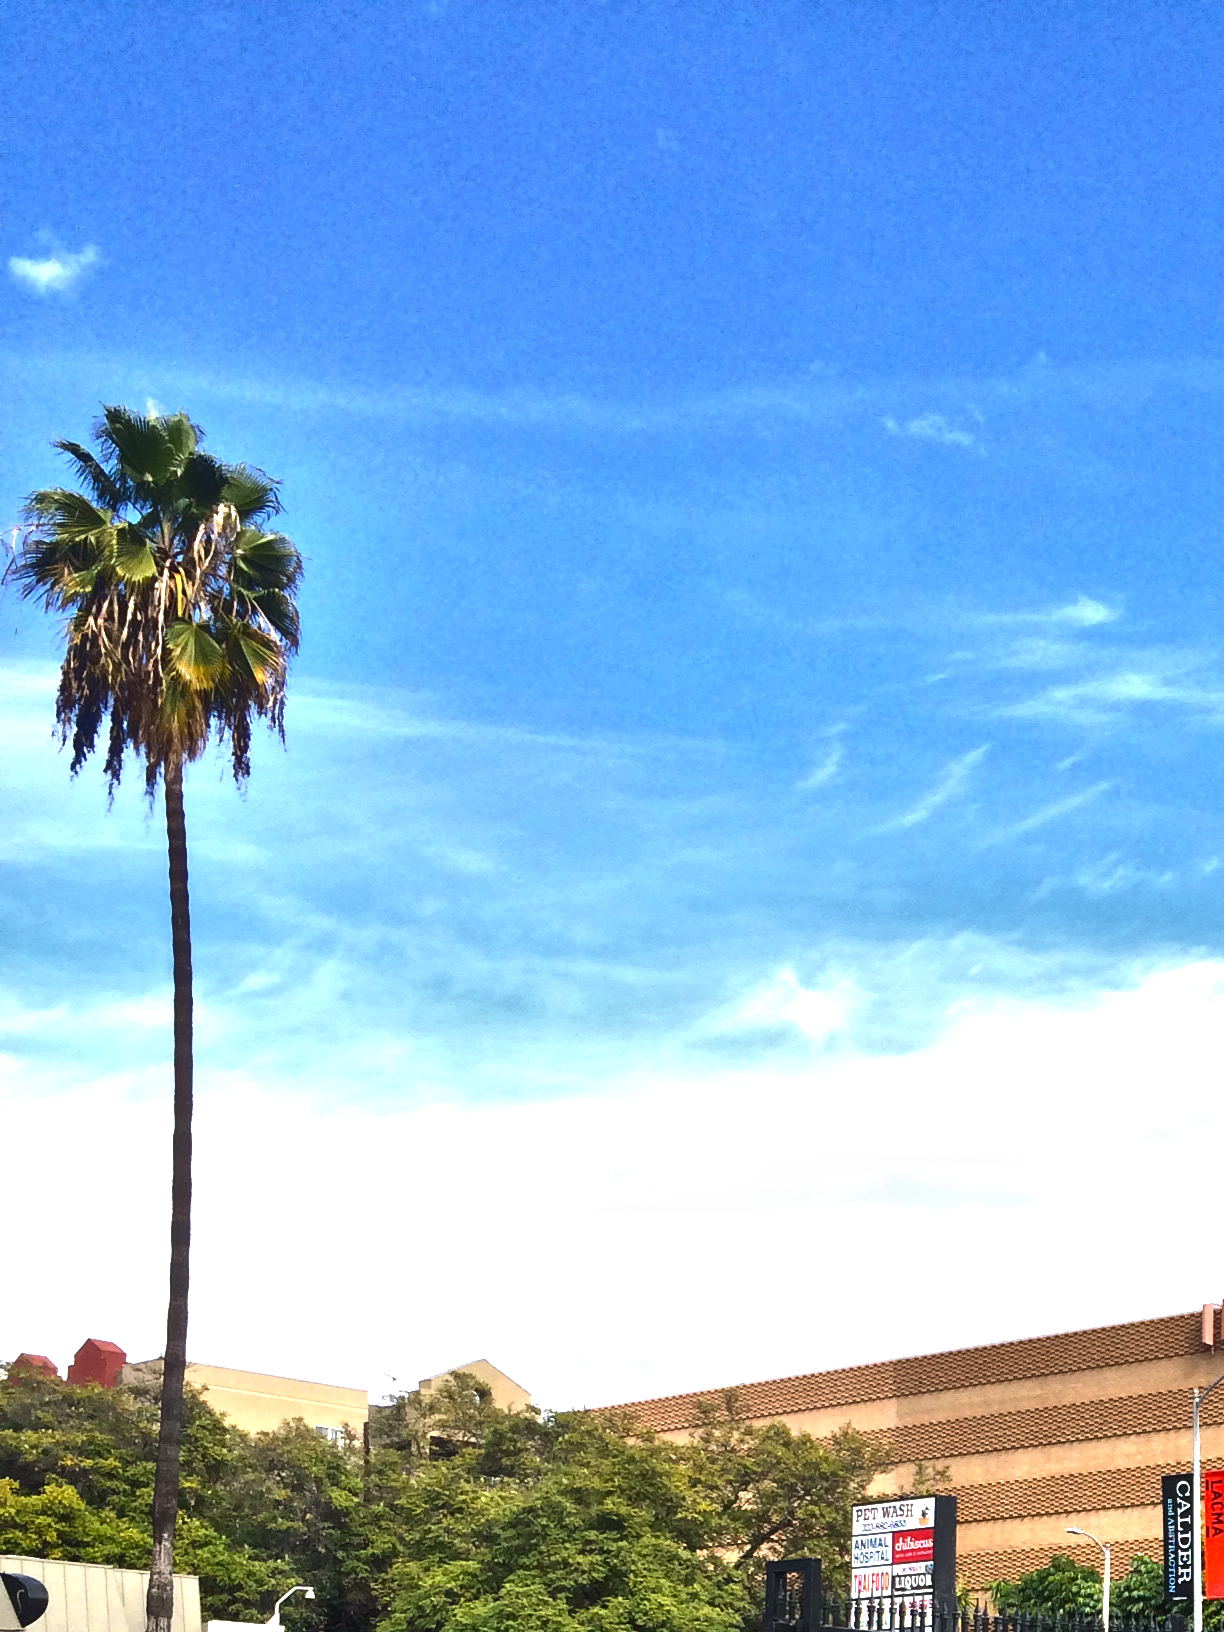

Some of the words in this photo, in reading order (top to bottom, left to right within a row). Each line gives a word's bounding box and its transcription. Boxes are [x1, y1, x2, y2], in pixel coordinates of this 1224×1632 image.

[856, 1507, 878, 1522] PET
[882, 1504, 914, 1518] WASH
[1167, 1499, 1175, 1516] and
[1210, 1480, 1224, 1538] LACMA
[1176, 1480, 1192, 1584] CALDER
[854, 1537, 889, 1550] ANIMAL
[854, 1550, 889, 1564] HOSPITAL
[1167, 1518, 1176, 1593] ABSTRACTION
[872, 1572, 889, 1591] FOOD
[895, 1574, 932, 1590] LIQUOR
